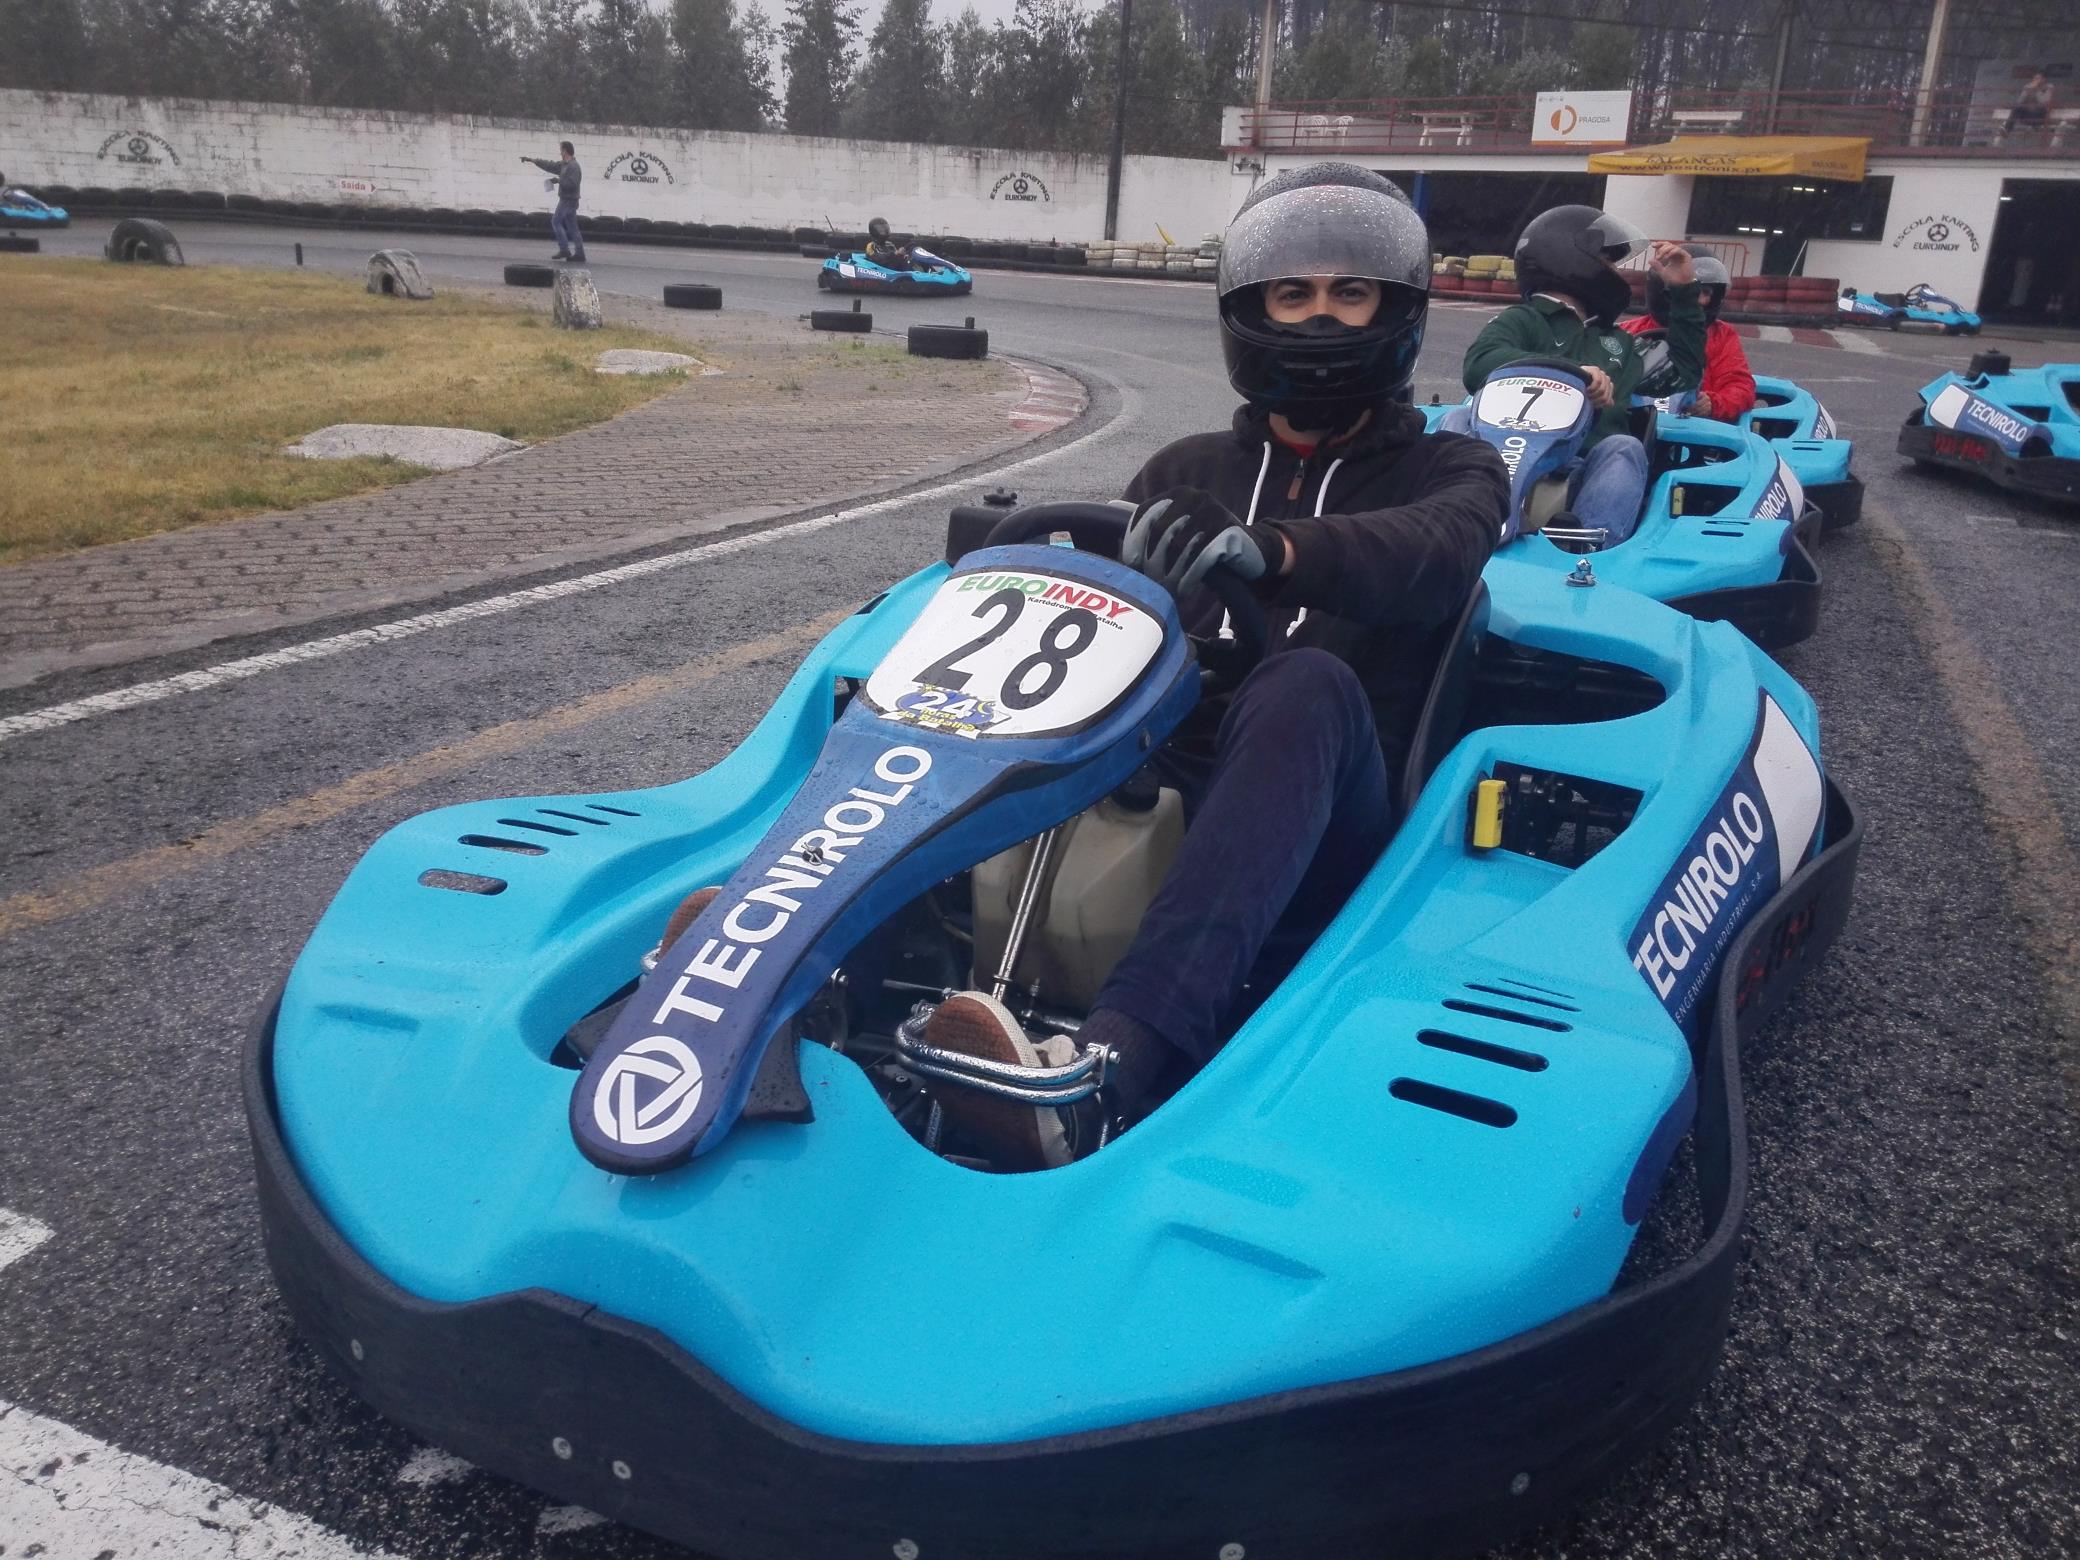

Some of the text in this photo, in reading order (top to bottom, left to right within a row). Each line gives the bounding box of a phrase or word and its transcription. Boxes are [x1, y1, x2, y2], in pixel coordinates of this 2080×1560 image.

[97, 130, 180, 166] ESCOLA KARTING
[604, 151, 675, 185] ESCOLA KARTING
[621, 174, 660, 184] EUROINDY
[989, 171, 1051, 202] ESCOLA KARTING
[1004, 194, 1038, 202] EUROINDY
[1893, 214, 1980, 253] ESCOLA KARTING
[1913, 241, 1960, 252] EUROINDY
[1497, 378, 1573, 392] EUROINDY
[1521, 386, 1545, 423] 7
[1967, 399, 2028, 443] TECNIROLO
[956, 574, 1134, 618] EUROINDY
[1027, 596, 1124, 631] Kartódrom atalha
[911, 587, 1098, 711] 28
[908, 690, 978, 719] 24
[652, 745, 933, 1025] TECNIROLO
[1674, 952, 1717, 1024] ENGENHARIA
